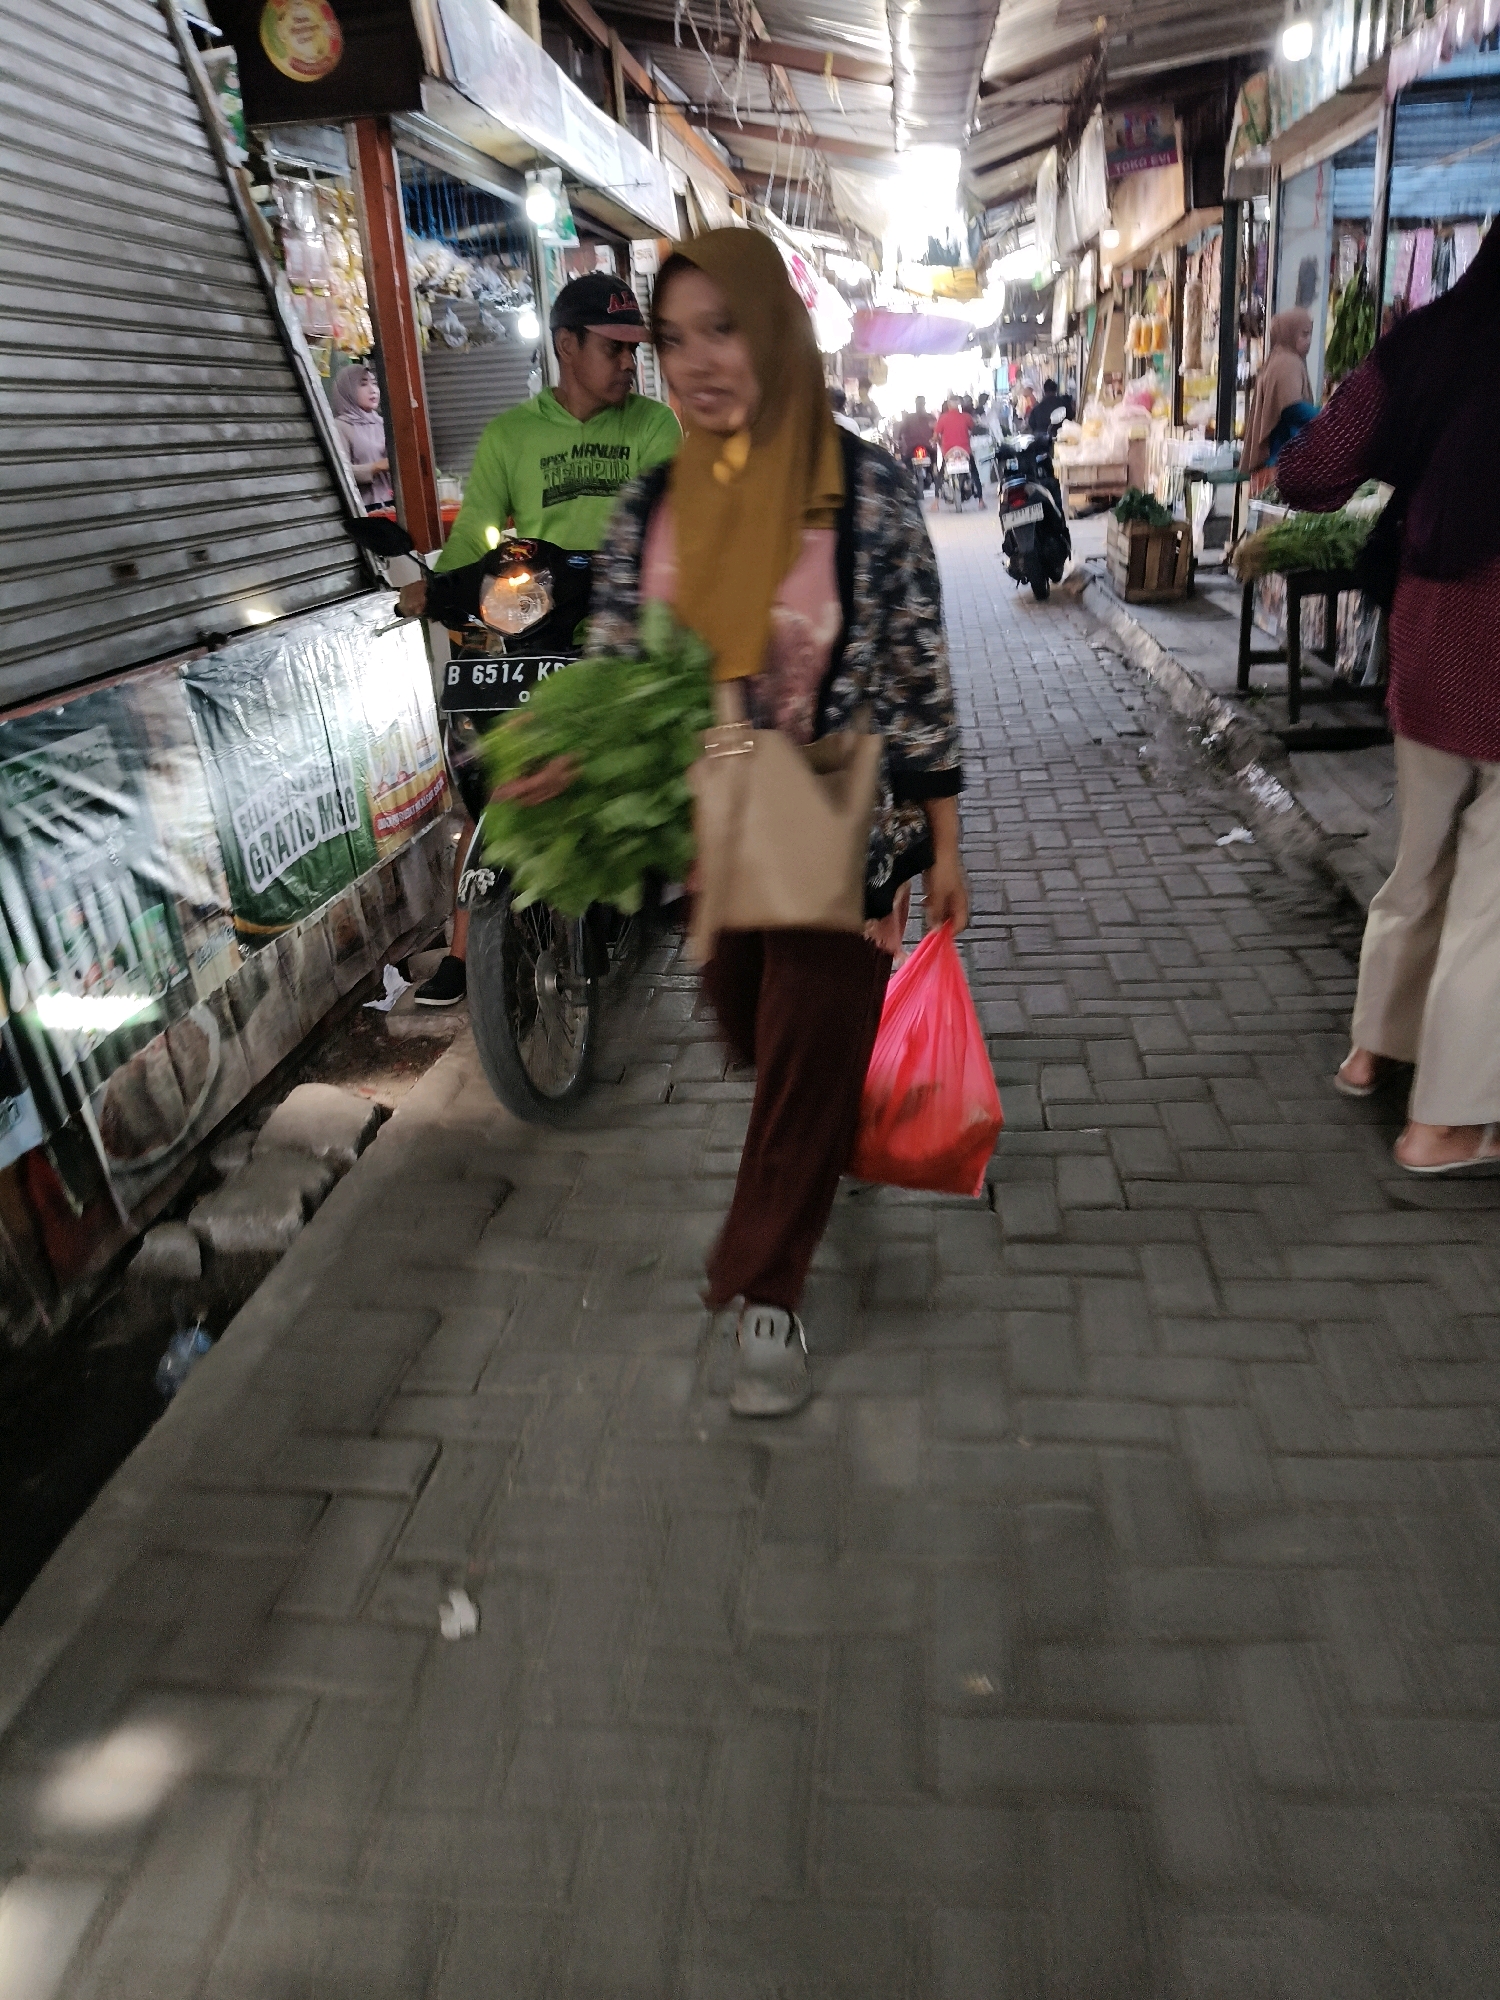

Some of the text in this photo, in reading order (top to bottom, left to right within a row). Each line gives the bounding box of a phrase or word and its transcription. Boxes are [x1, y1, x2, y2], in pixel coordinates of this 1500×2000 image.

[1114, 153, 1171, 173] TOKO EVI
[447, 665, 461, 686] B
[472, 662, 525, 685] 6514
[249, 800, 317, 885] GRATIS
[316, 786, 358, 837] MSG
